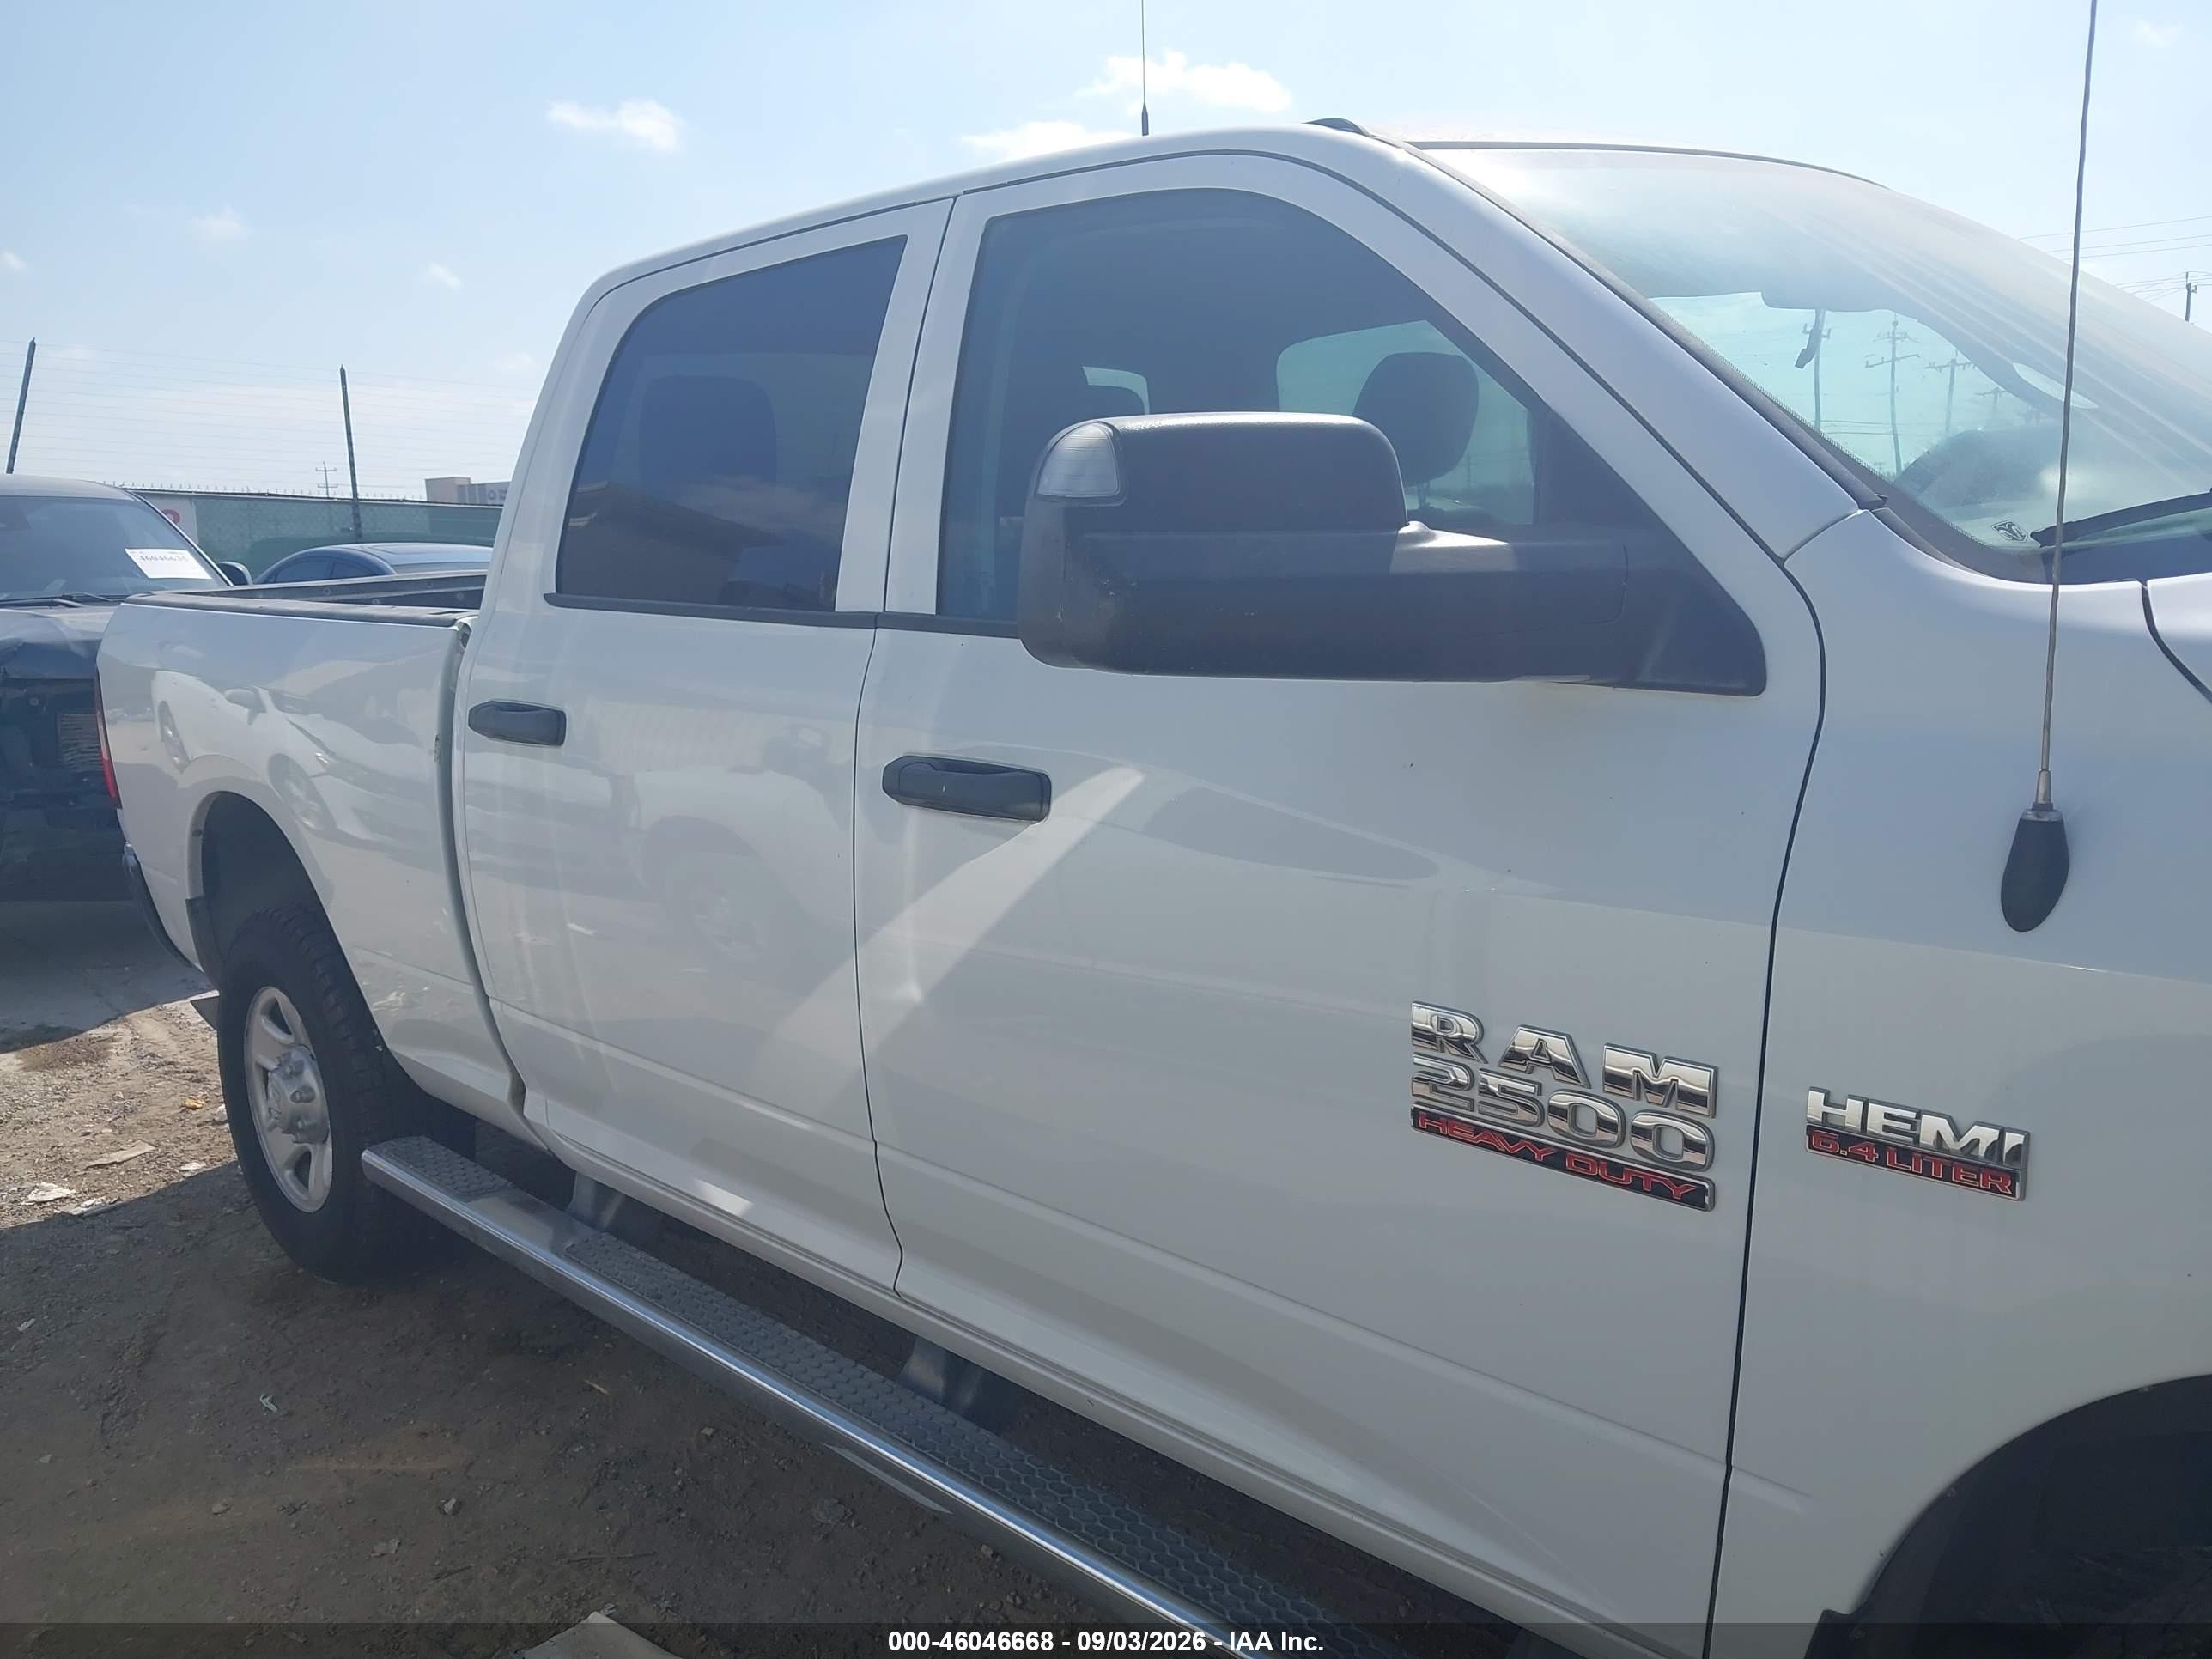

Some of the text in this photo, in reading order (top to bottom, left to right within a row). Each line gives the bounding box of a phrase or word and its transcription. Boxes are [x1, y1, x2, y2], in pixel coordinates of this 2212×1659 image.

[1411, 1000, 1717, 1119] RAM
[1411, 1051, 1715, 1172] 2500
[1806, 1086, 2030, 1169] HEMI
[1418, 1113, 1698, 1200] HEAVY DUTY
[1811, 1129, 2013, 1195] 6.4 LITER
